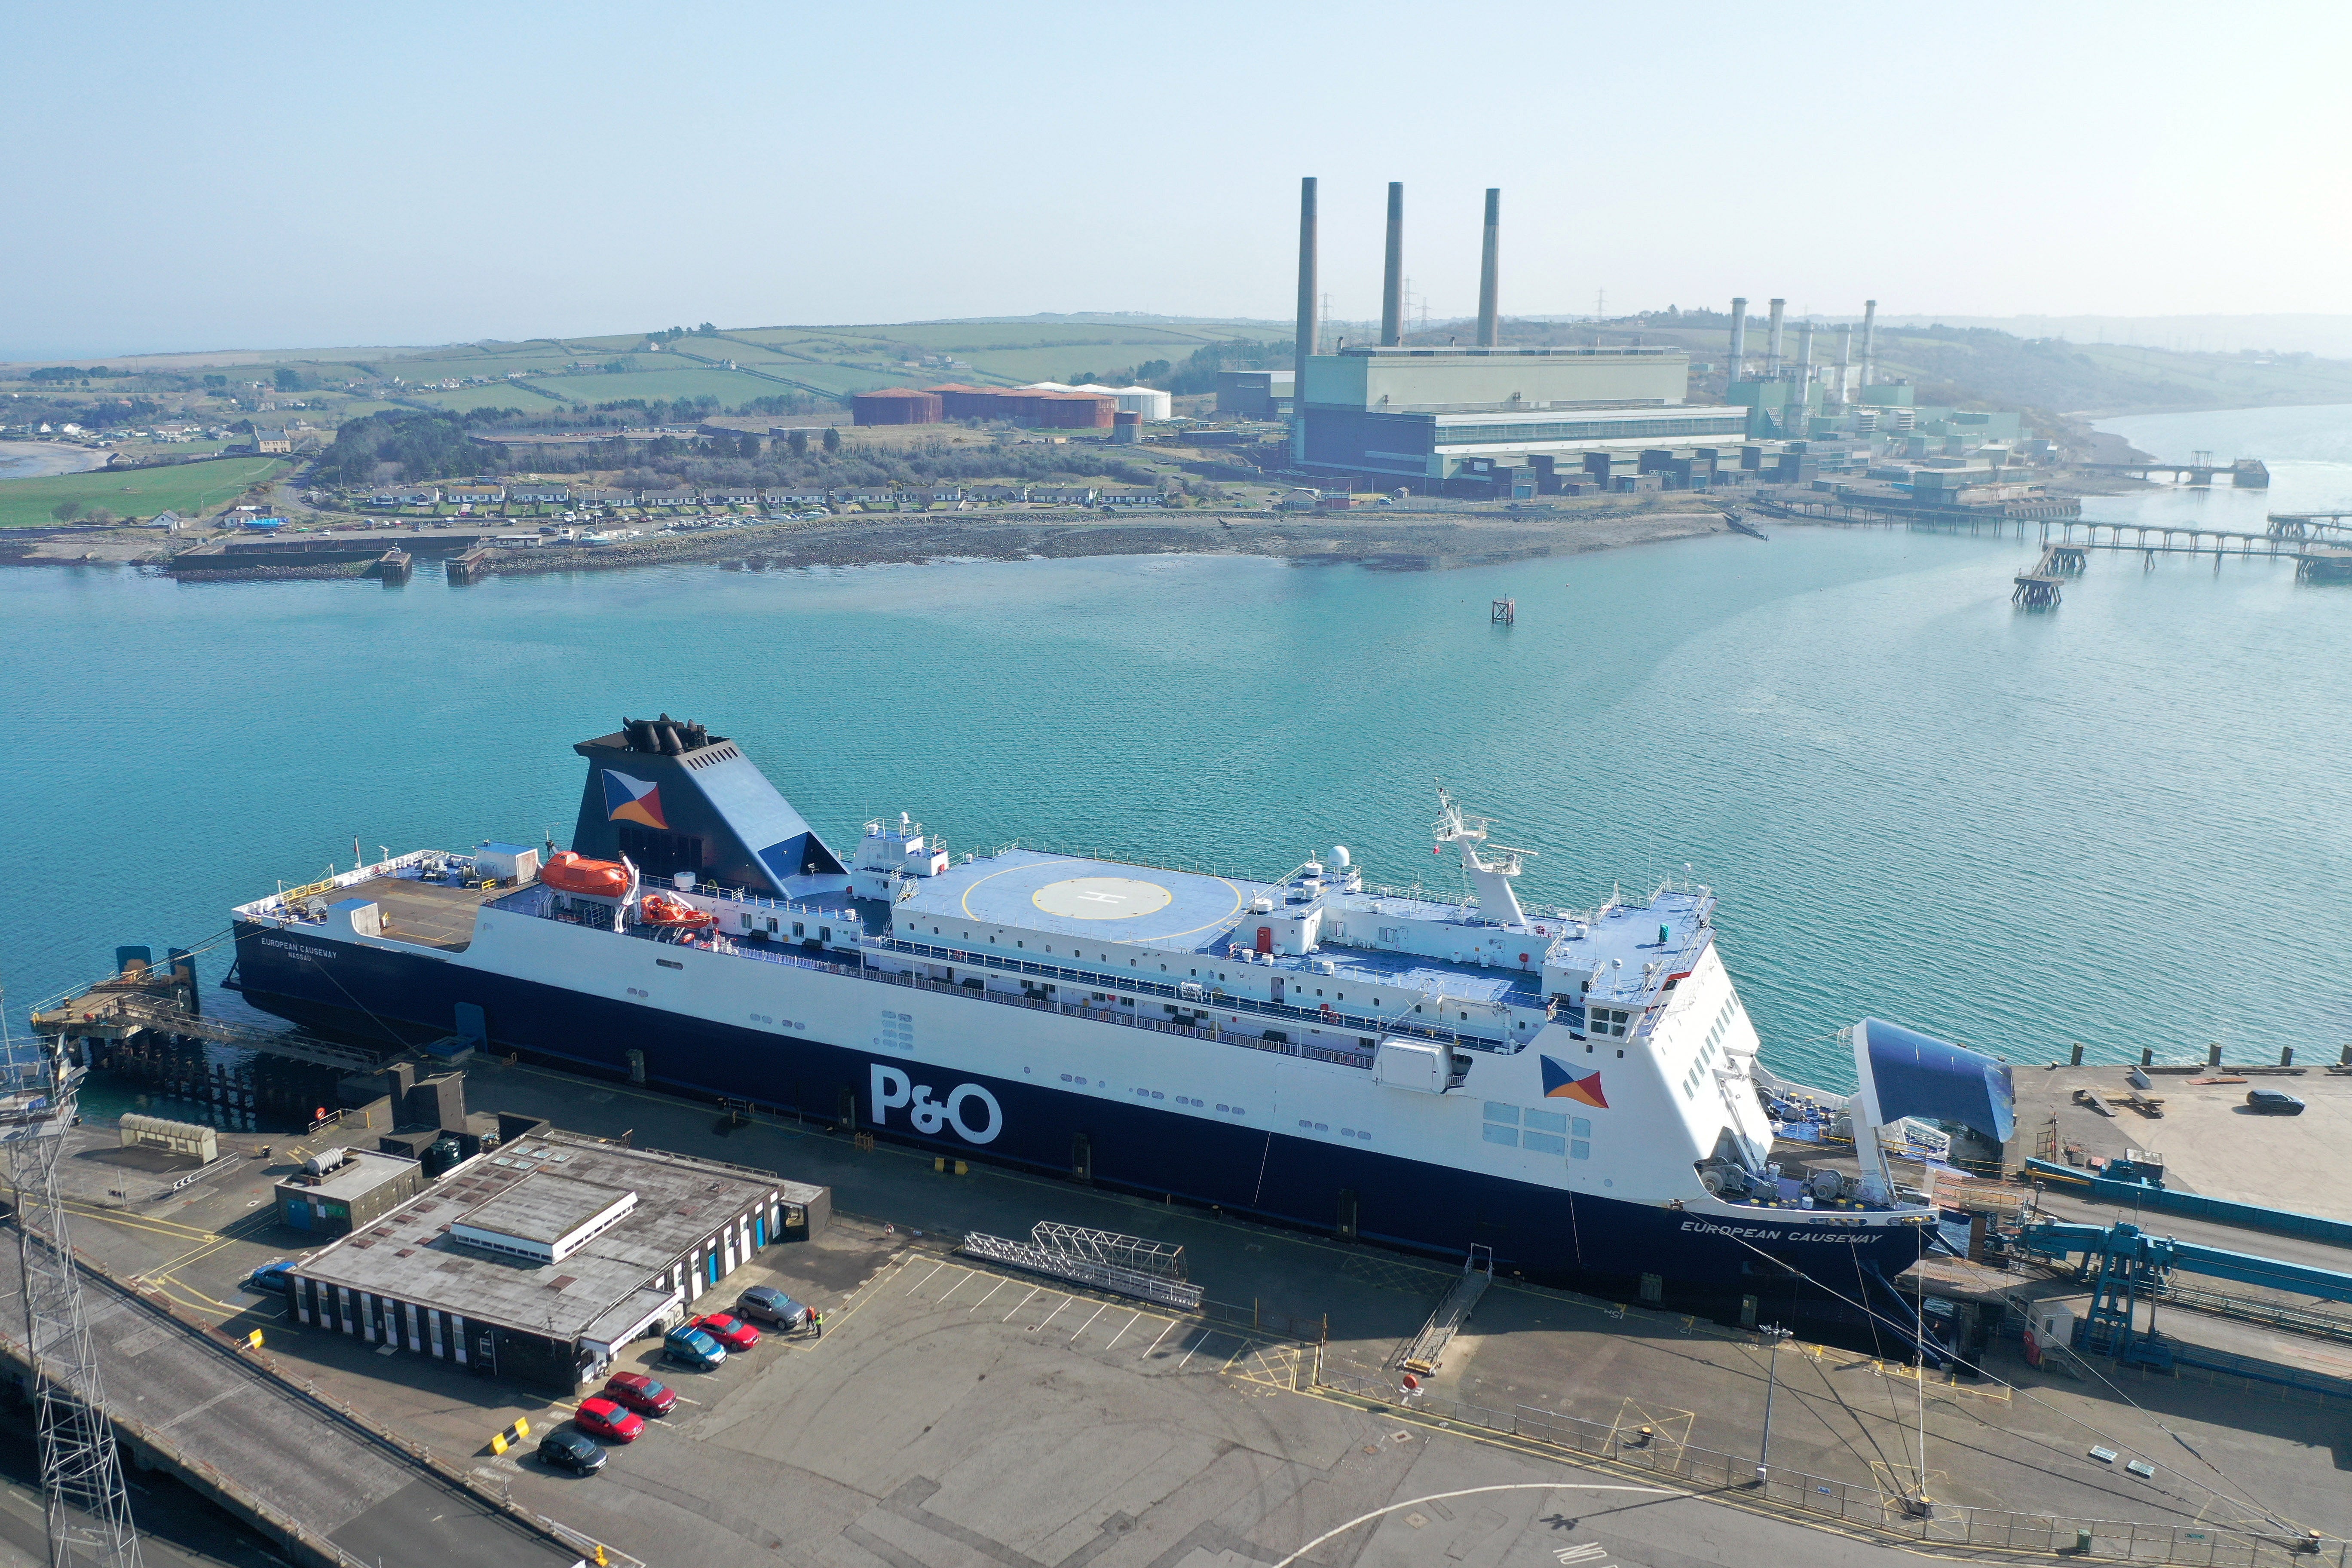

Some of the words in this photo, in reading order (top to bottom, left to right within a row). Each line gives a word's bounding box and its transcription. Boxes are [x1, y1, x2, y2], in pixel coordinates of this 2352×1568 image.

[262, 938, 297, 951] EUROPEAN
[300, 946, 337, 959] CAUSEWAY
[288, 952, 312, 962] NASSAU
[870, 1063, 1003, 1144] P&O
[1680, 1221, 1781, 1240] EUROPEAN
[1788, 1231, 1883, 1243] CAUSEWAY
[1553, 1542, 1608, 1565] NO
